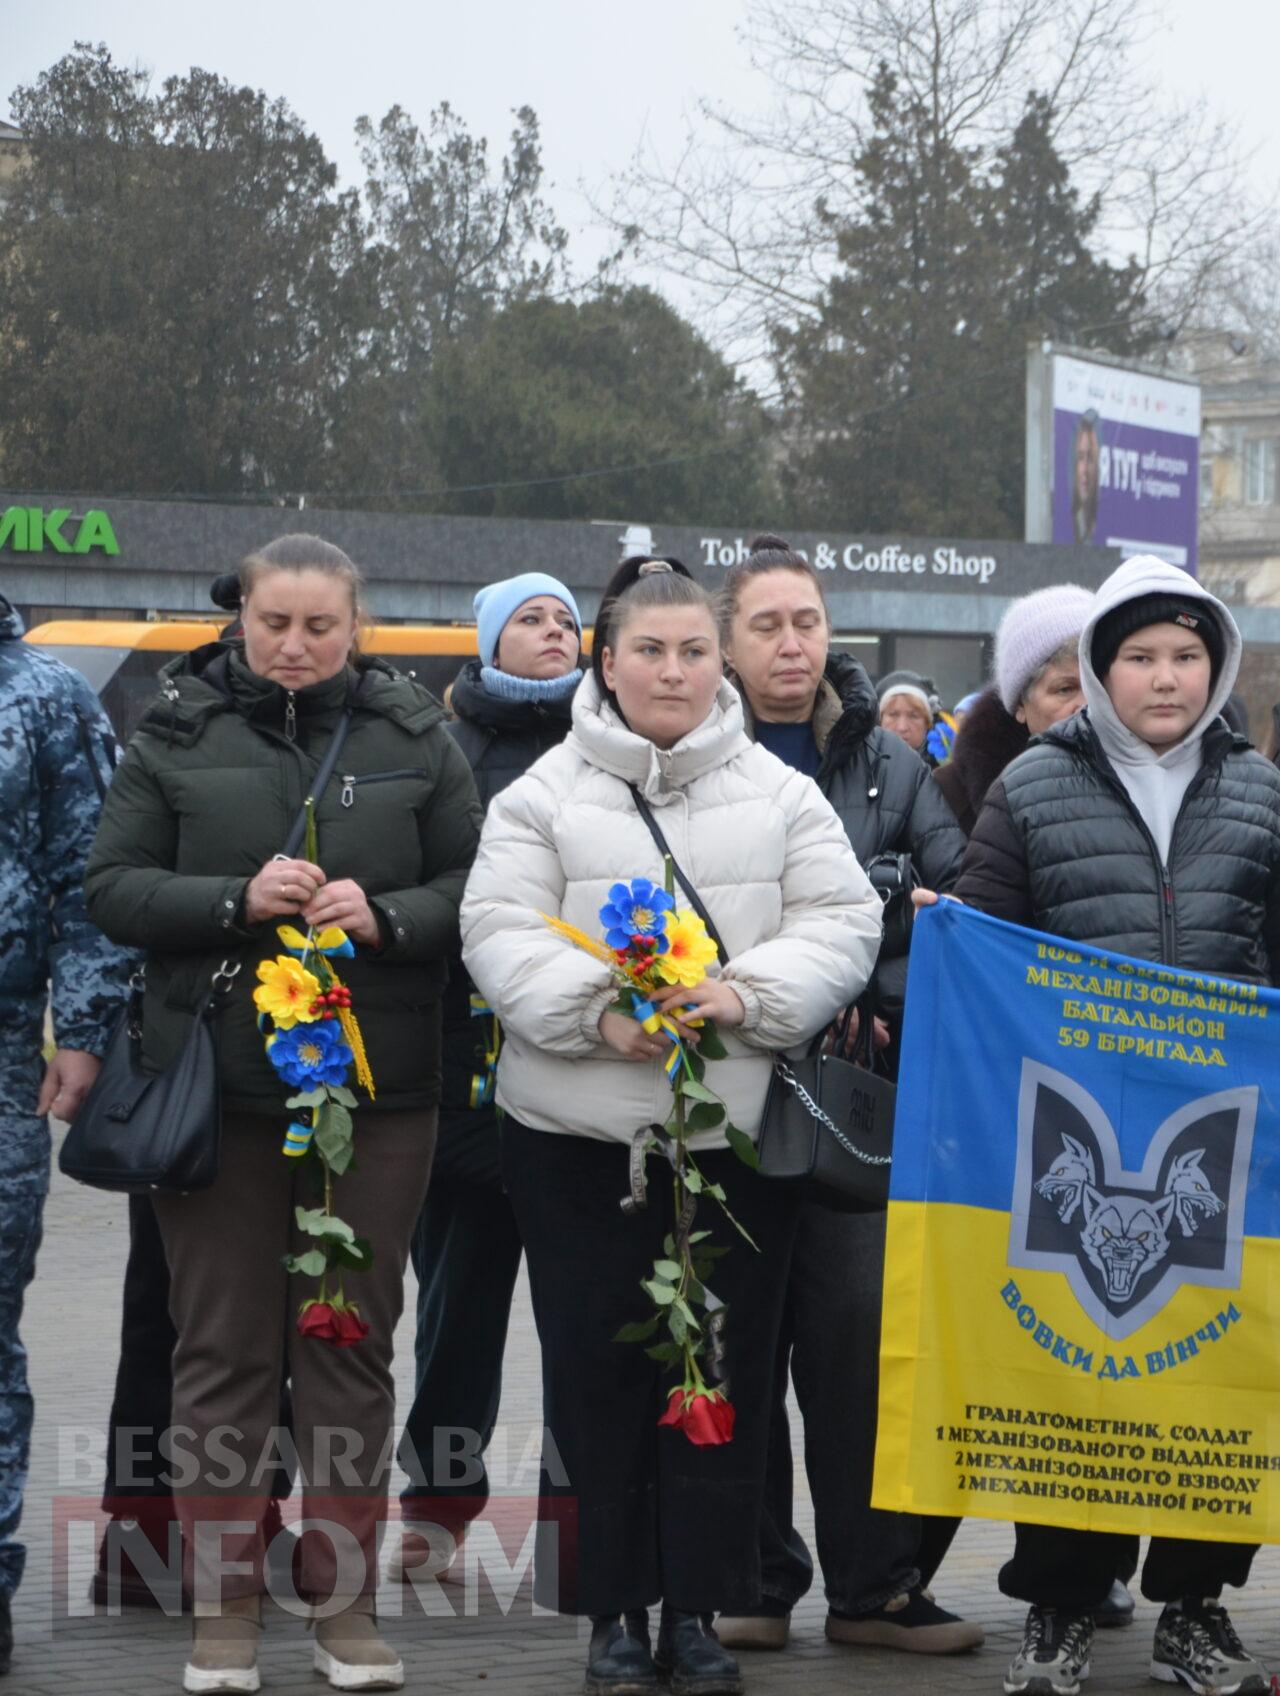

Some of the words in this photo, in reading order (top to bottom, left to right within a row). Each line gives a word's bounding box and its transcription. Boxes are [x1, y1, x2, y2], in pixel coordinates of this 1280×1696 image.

[814, 543, 836, 570] &
[842, 544, 926, 574] Coffee
[932, 547, 996, 584] Shop
[1062, 999, 1226, 1040] БАТАЛЬЙОН
[1058, 1026, 1090, 1048] 59
[1097, 1033, 1228, 1067] БРИГАДА
[1000, 1278, 1094, 1373] ВОВКИ
[1098, 1355, 1142, 1381] ДА
[1145, 1301, 1242, 1375] ВІНЧИ
[936, 1426, 944, 1441] 1
[948, 1426, 1146, 1461] МЕХАНІЗОВАНОГО
[965, 1404, 1166, 1441] ГРАНАТОМЕТНИК,
[1170, 1424, 1253, 1446] СОЛДАТ
[955, 1450, 964, 1466] 2
[966, 1451, 1172, 1487] МЕХАНІЗОВАНОГО
[1177, 1472, 1262, 1494] ВЗВОДУ
[957, 1474, 966, 1490] 2
[1191, 1496, 1252, 1516] РОТИ
